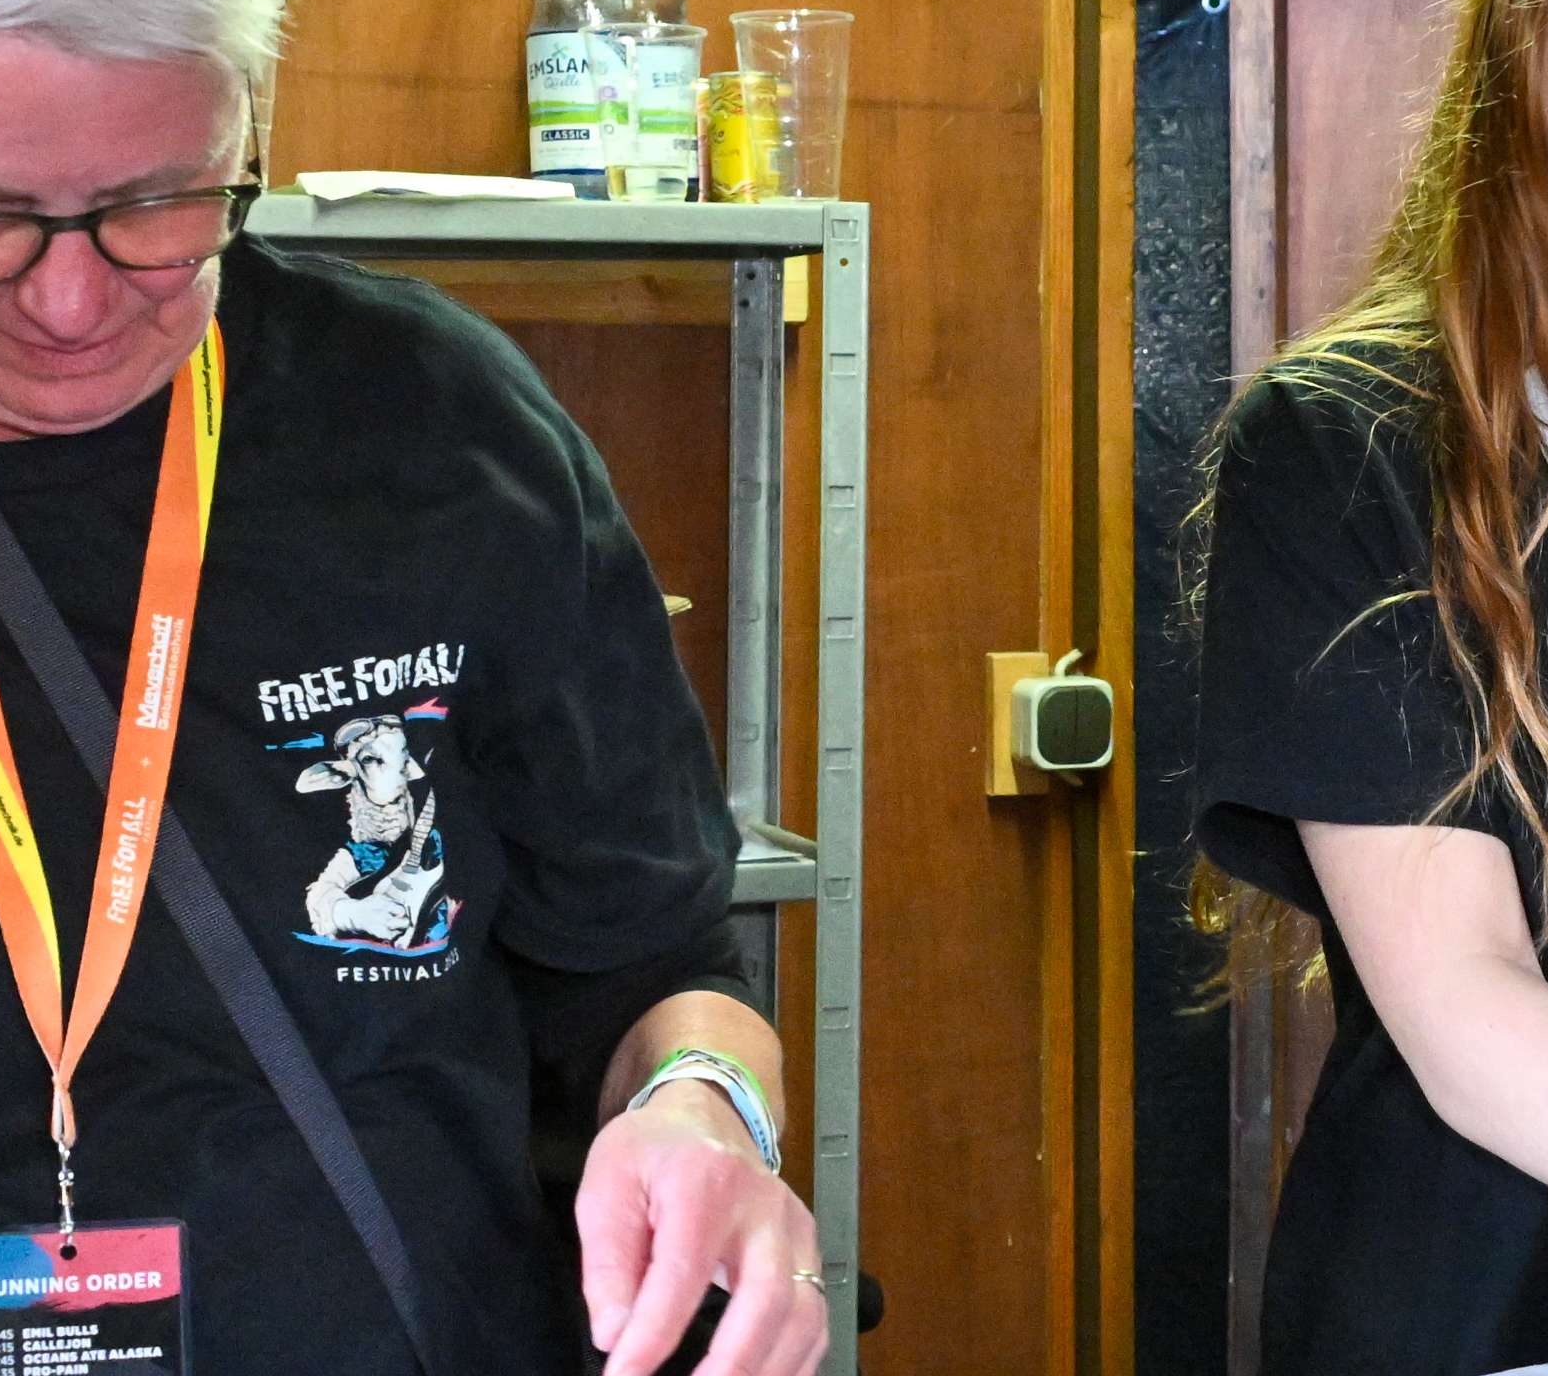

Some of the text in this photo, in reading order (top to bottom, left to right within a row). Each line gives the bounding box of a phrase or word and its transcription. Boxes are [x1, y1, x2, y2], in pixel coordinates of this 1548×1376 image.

[542, 129, 588, 142] CLASSIC
[136, 614, 172, 728] Meyerhoff
[258, 666, 353, 722] FREE
[352, 653, 413, 701] FOR
[106, 796, 146, 924] FREE FOR ALL
[337, 963, 442, 982] FESTIVAL
[86, 1272, 162, 1291] ORDER
[22, 1327, 54, 1339] EMIL
[56, 1325, 99, 1337] BULLS
[23, 1338, 92, 1352] CALLEJON
[23, 1351, 78, 1364] OCEANS
[81, 1349, 106, 1362] ATE
[108, 1346, 163, 1360] ALASKA
